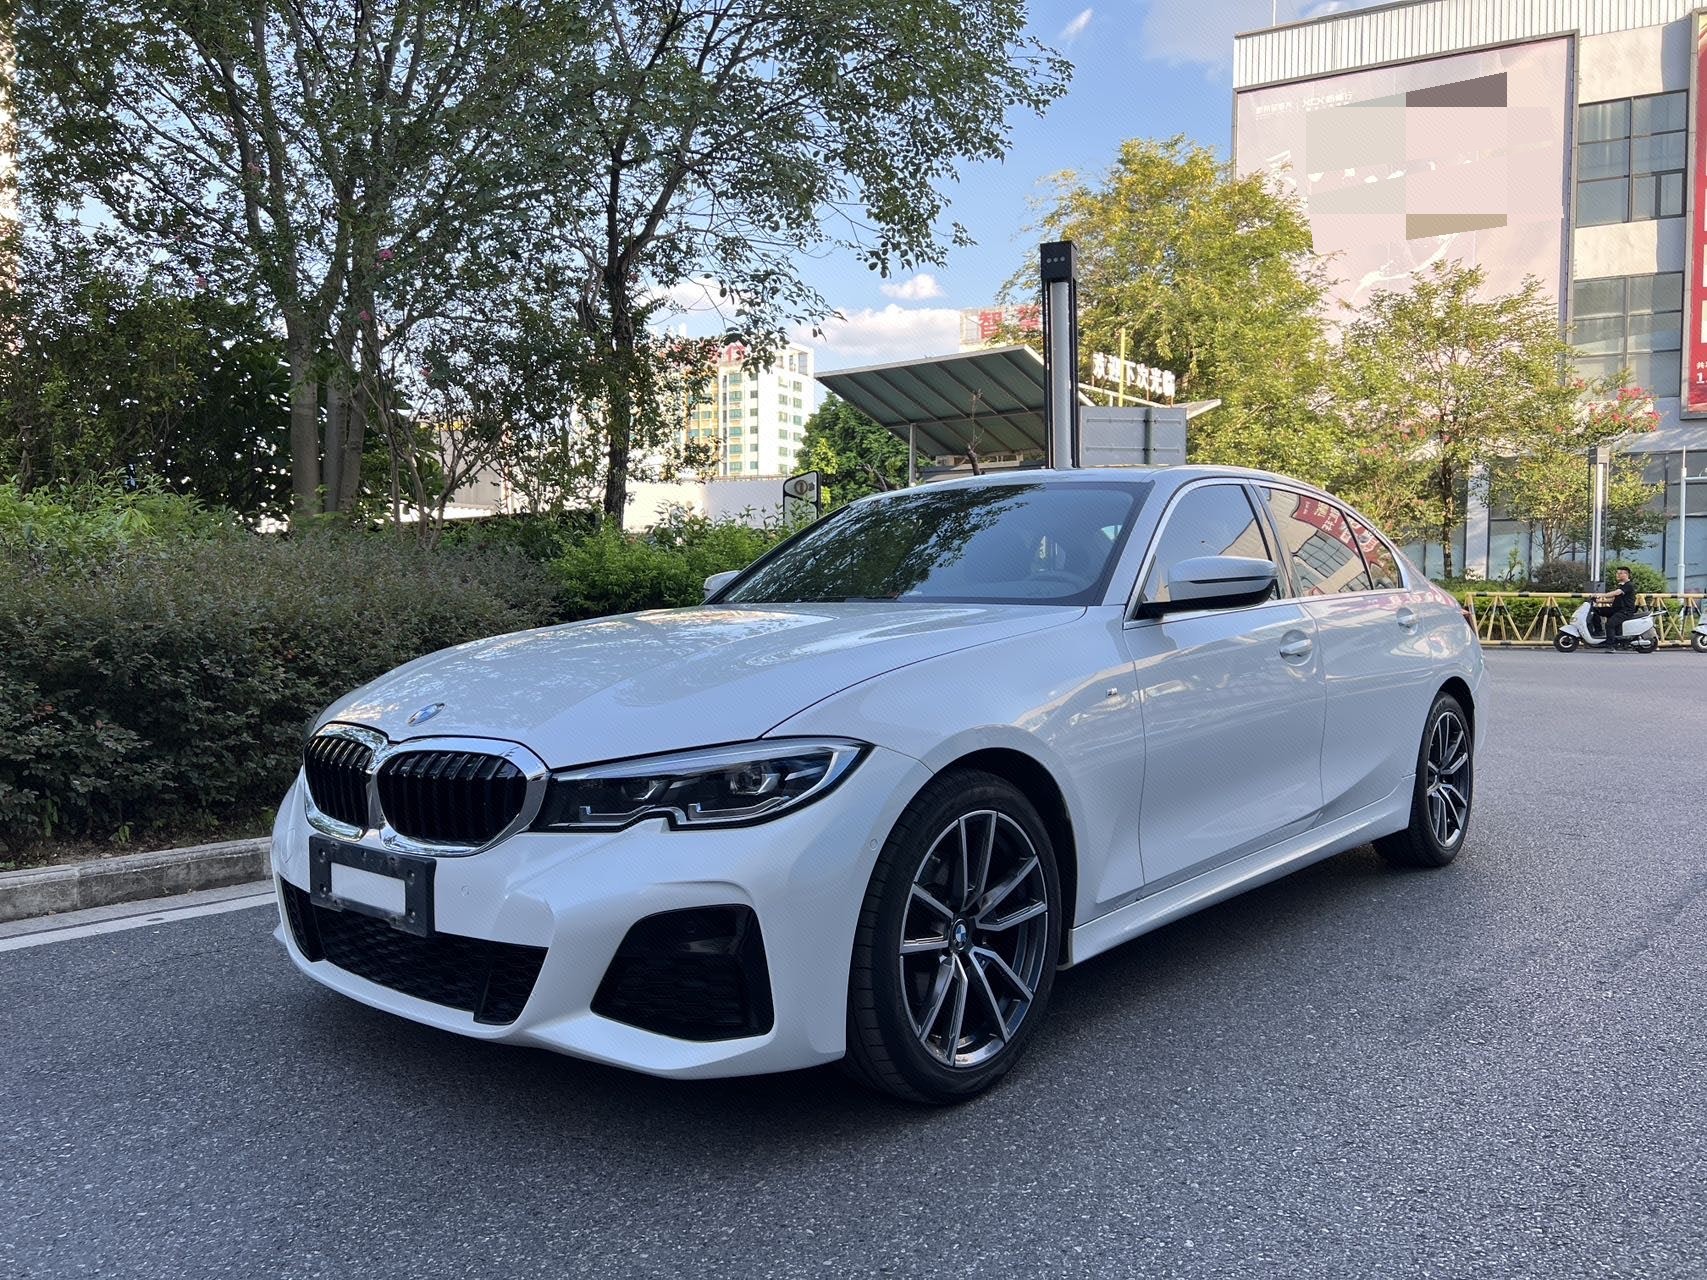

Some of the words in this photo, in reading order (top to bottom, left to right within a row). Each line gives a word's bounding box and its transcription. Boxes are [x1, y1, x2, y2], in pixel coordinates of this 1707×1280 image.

[1093, 351, 1176, 397] 欢迎下次光临
